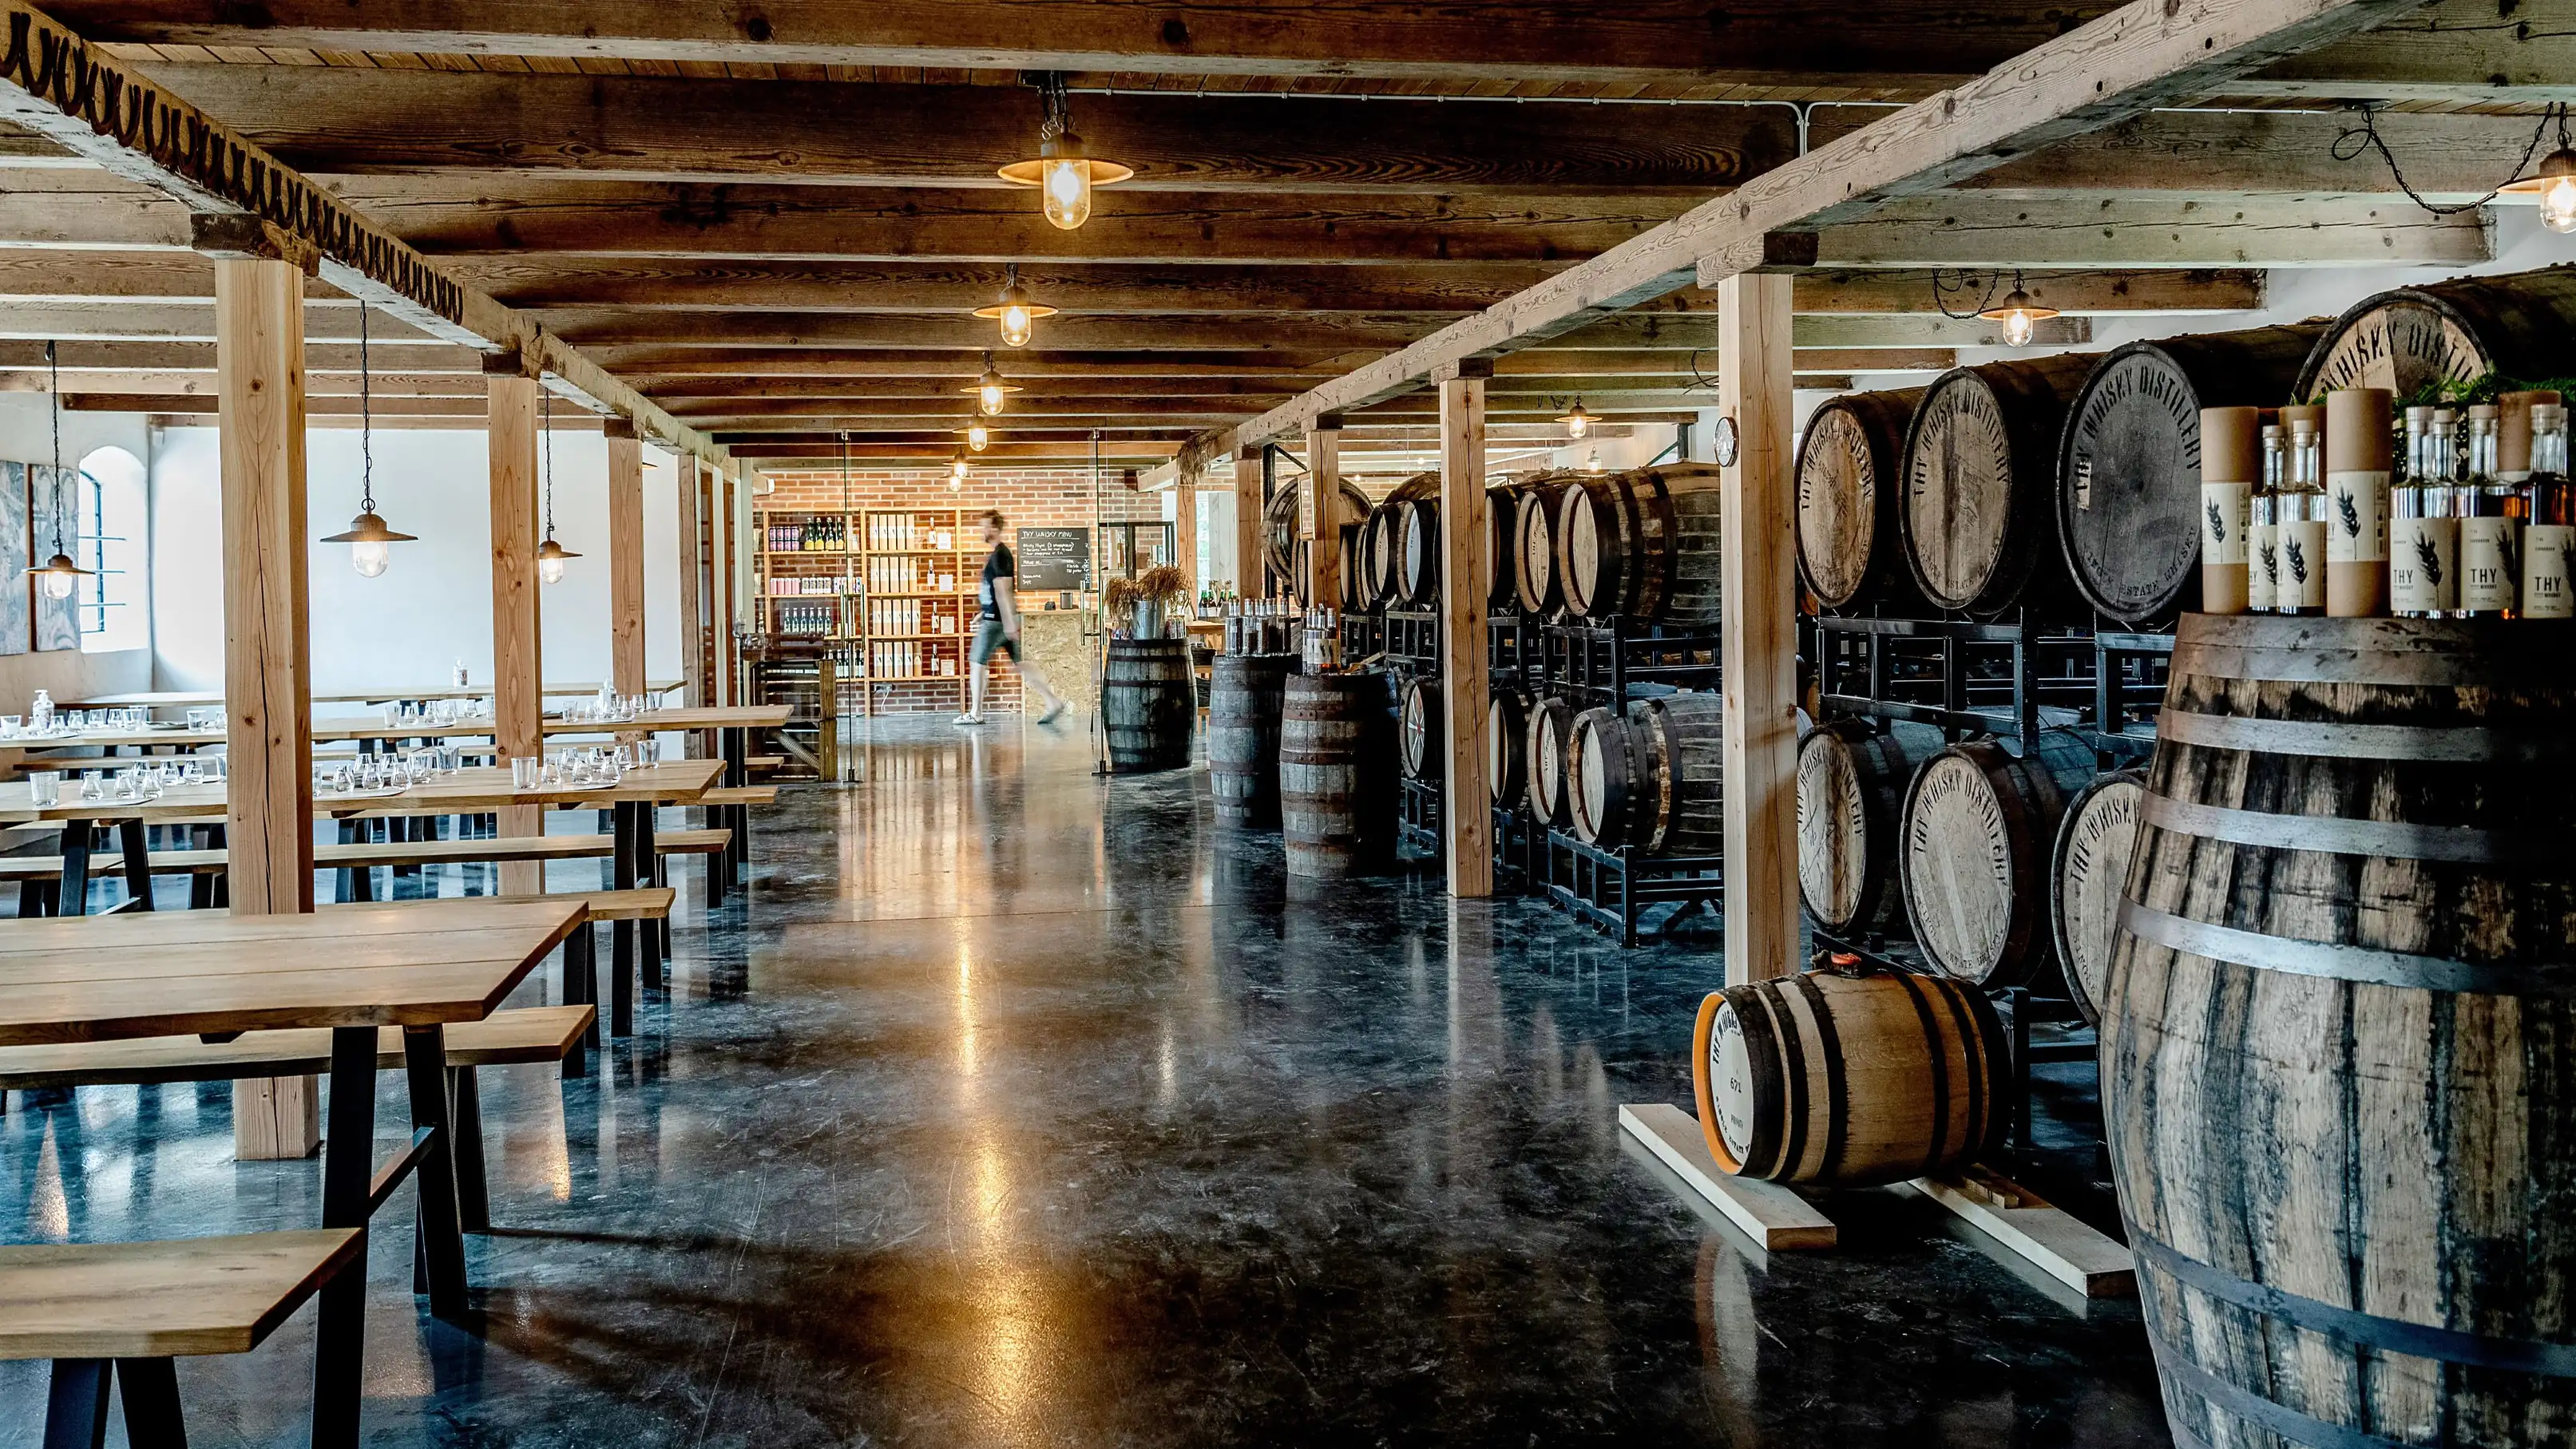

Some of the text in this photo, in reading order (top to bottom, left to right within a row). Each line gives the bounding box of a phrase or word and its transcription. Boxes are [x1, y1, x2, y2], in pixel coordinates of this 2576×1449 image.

[1914, 389, 2009, 499] THY WHISKY DISTILLERY
[2074, 365, 2201, 493] THY WHISKY DISTILLERY
[1801, 475, 1812, 511] THY
[2163, 527, 2197, 582] WHISKY
[2394, 569, 2414, 584] THY
[2471, 568, 2498, 584] THY
[2534, 576, 2562, 592] THY
[1798, 744, 1826, 788] WHISKY
[1915, 768, 2009, 886] THY WHISKY DISTILLERY
[2070, 798, 2140, 884] THY WHISKY
[1712, 1035, 1721, 1065] THY
[1730, 1077, 1742, 1094] 671
